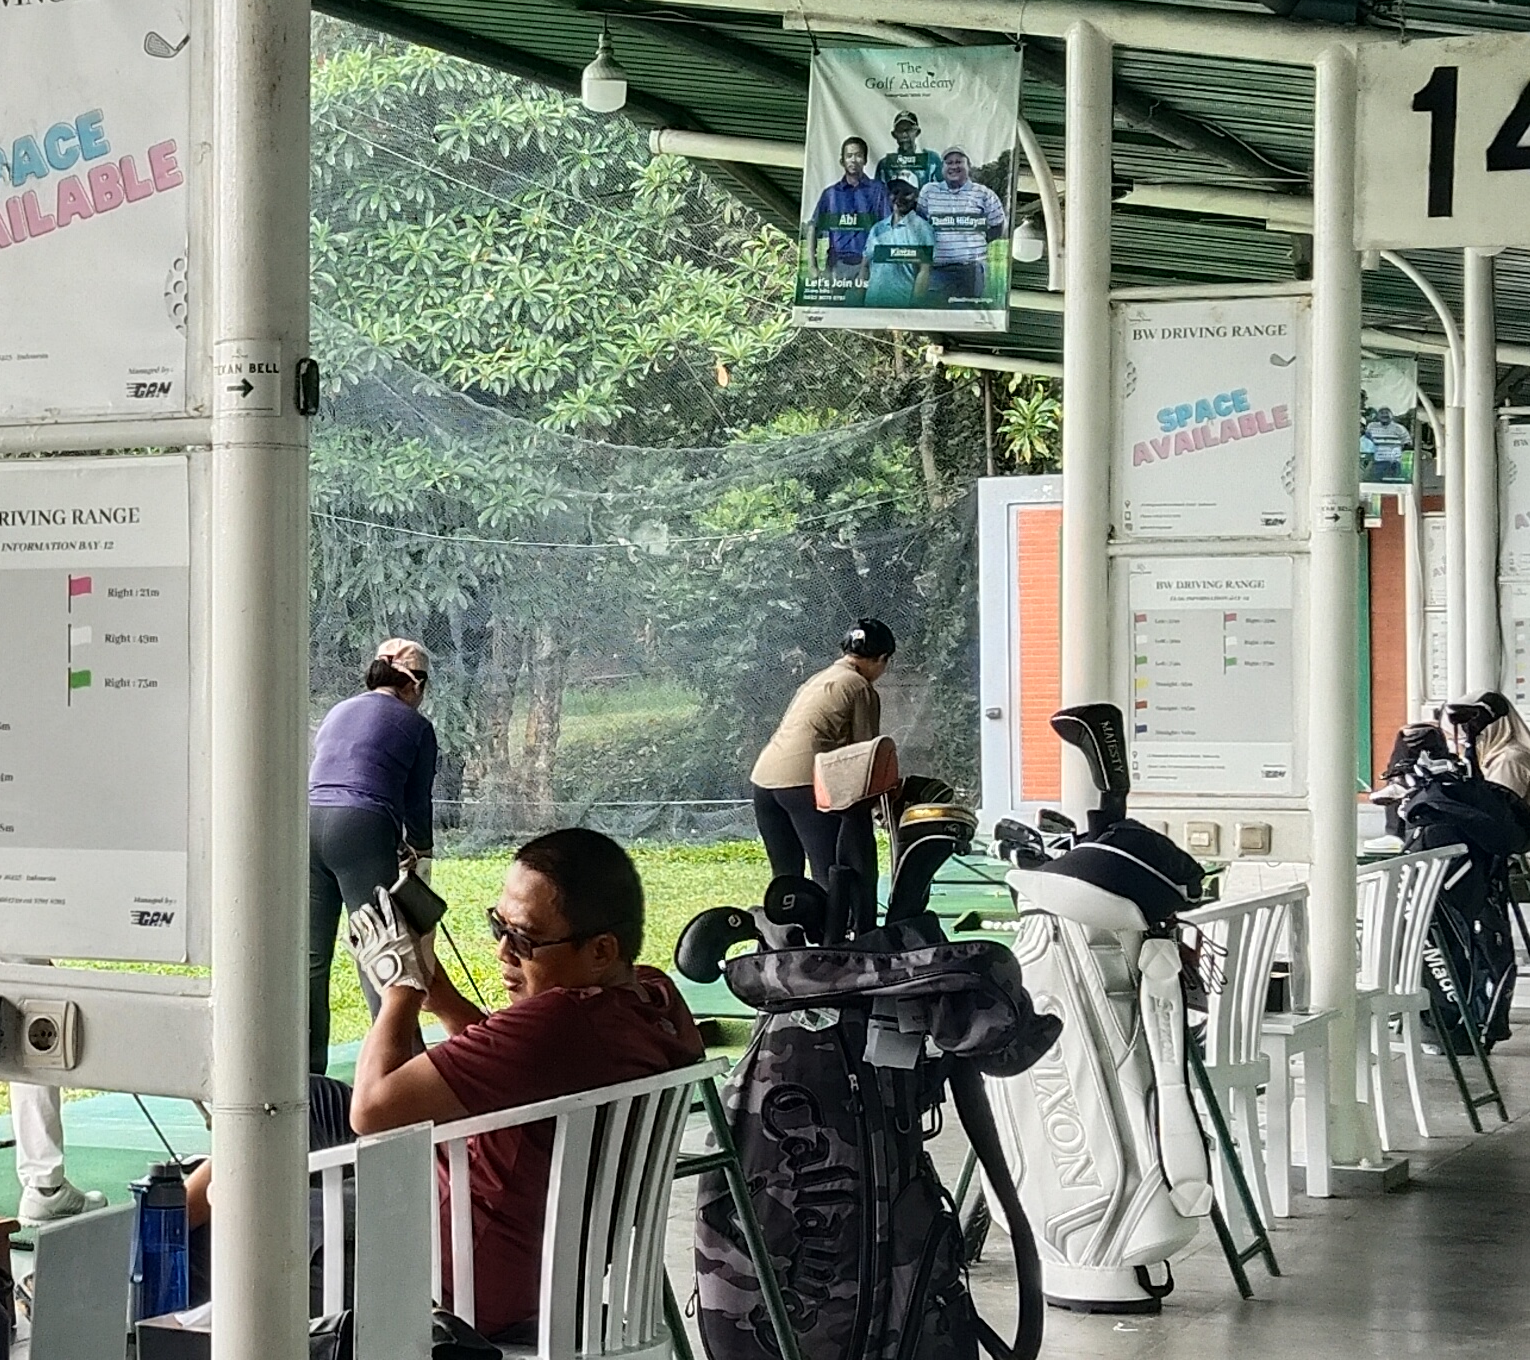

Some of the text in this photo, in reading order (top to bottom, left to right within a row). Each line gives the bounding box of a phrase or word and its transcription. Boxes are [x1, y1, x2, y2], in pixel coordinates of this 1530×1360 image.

[897, 61, 922, 74] The
[865, 76, 955, 92] Golf Academy
[838, 213, 858, 226] Abi
[831, 278, 853, 288] Join
[855, 278, 869, 288] Us
[1132, 324, 1287, 340] BW DRIVING RANGE
[249, 363, 279, 374] BELL
[1156, 388, 1251, 433] SPACE
[1133, 404, 1292, 467] AVAILABLE
[72, 507, 140, 525] RANGE
[1, 542, 76, 552] INFORMATION
[108, 588, 133, 599] Right
[104, 634, 131, 645] Right
[104, 678, 131, 689] Right
